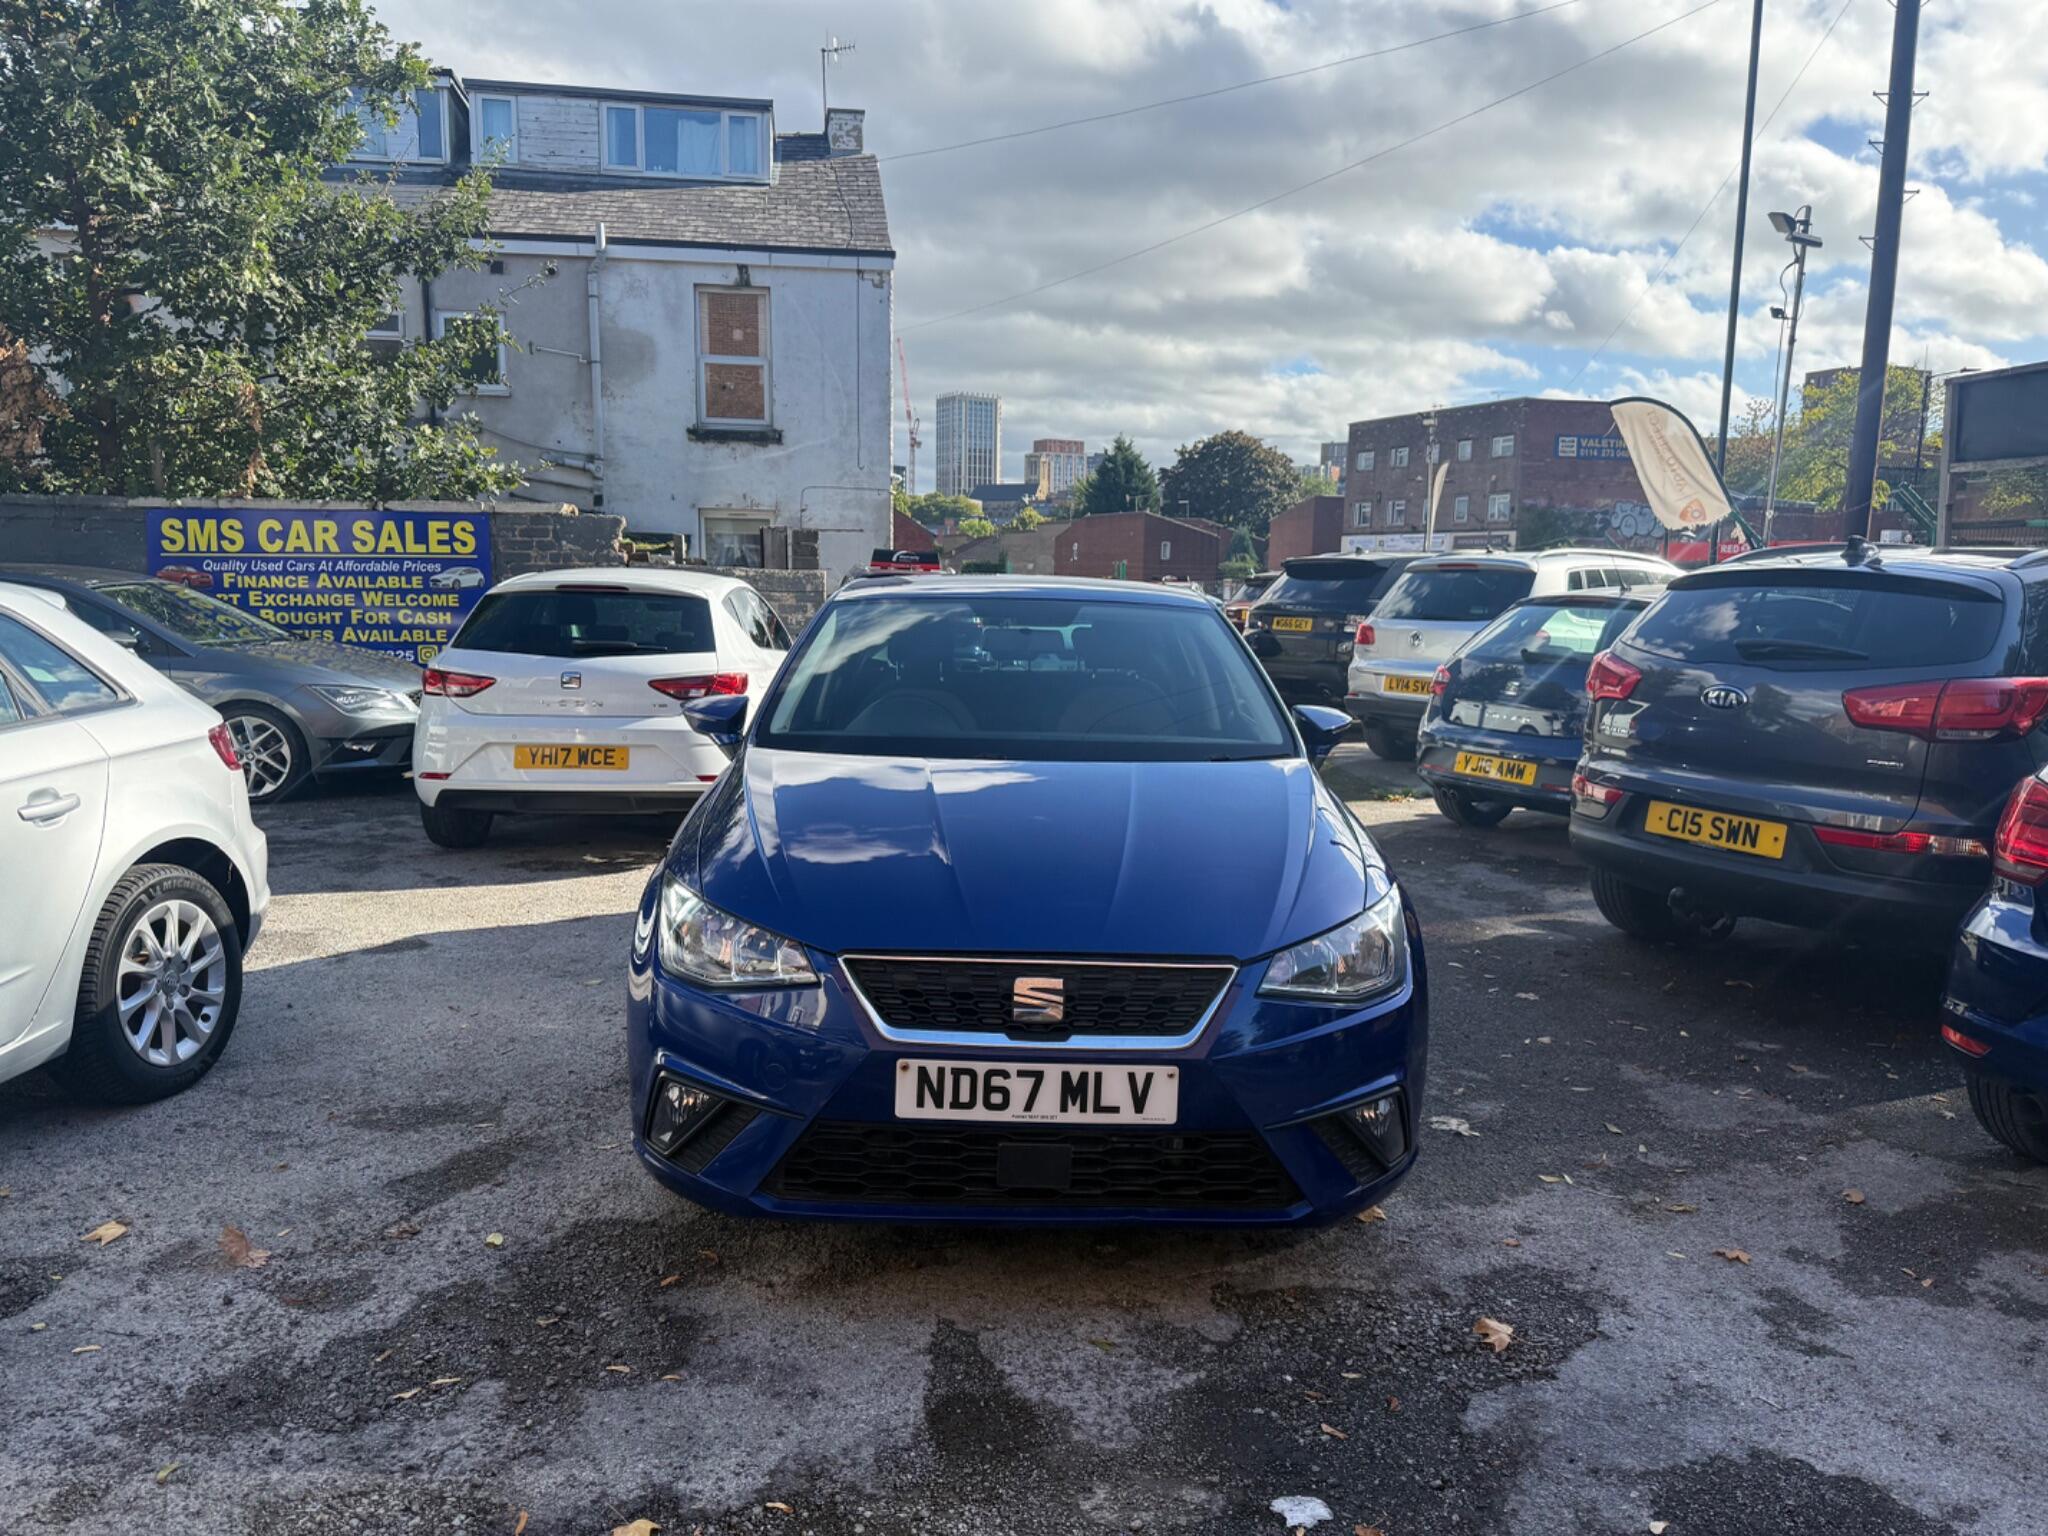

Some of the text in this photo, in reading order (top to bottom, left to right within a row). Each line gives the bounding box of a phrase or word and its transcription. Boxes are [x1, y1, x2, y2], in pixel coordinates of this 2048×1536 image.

[160, 518, 476, 554] SMS CAR SALES
[203, 559, 441, 573] Quality Used Cars At Affordable Prices
[223, 573, 424, 589] FINANCE AVAILABLE
[248, 590, 355, 606] EXCHANGE
[361, 591, 459, 607] WELCOME
[260, 608, 452, 625] BOUGHT FOR CASH
[341, 626, 448, 642] AVAILABLE
[1707, 690, 1739, 706] KIA
[529, 748, 616, 766] YH17 WCE
[1708, 817, 1760, 849] SWN
[916, 1066, 1154, 1114] ND67 MLV
